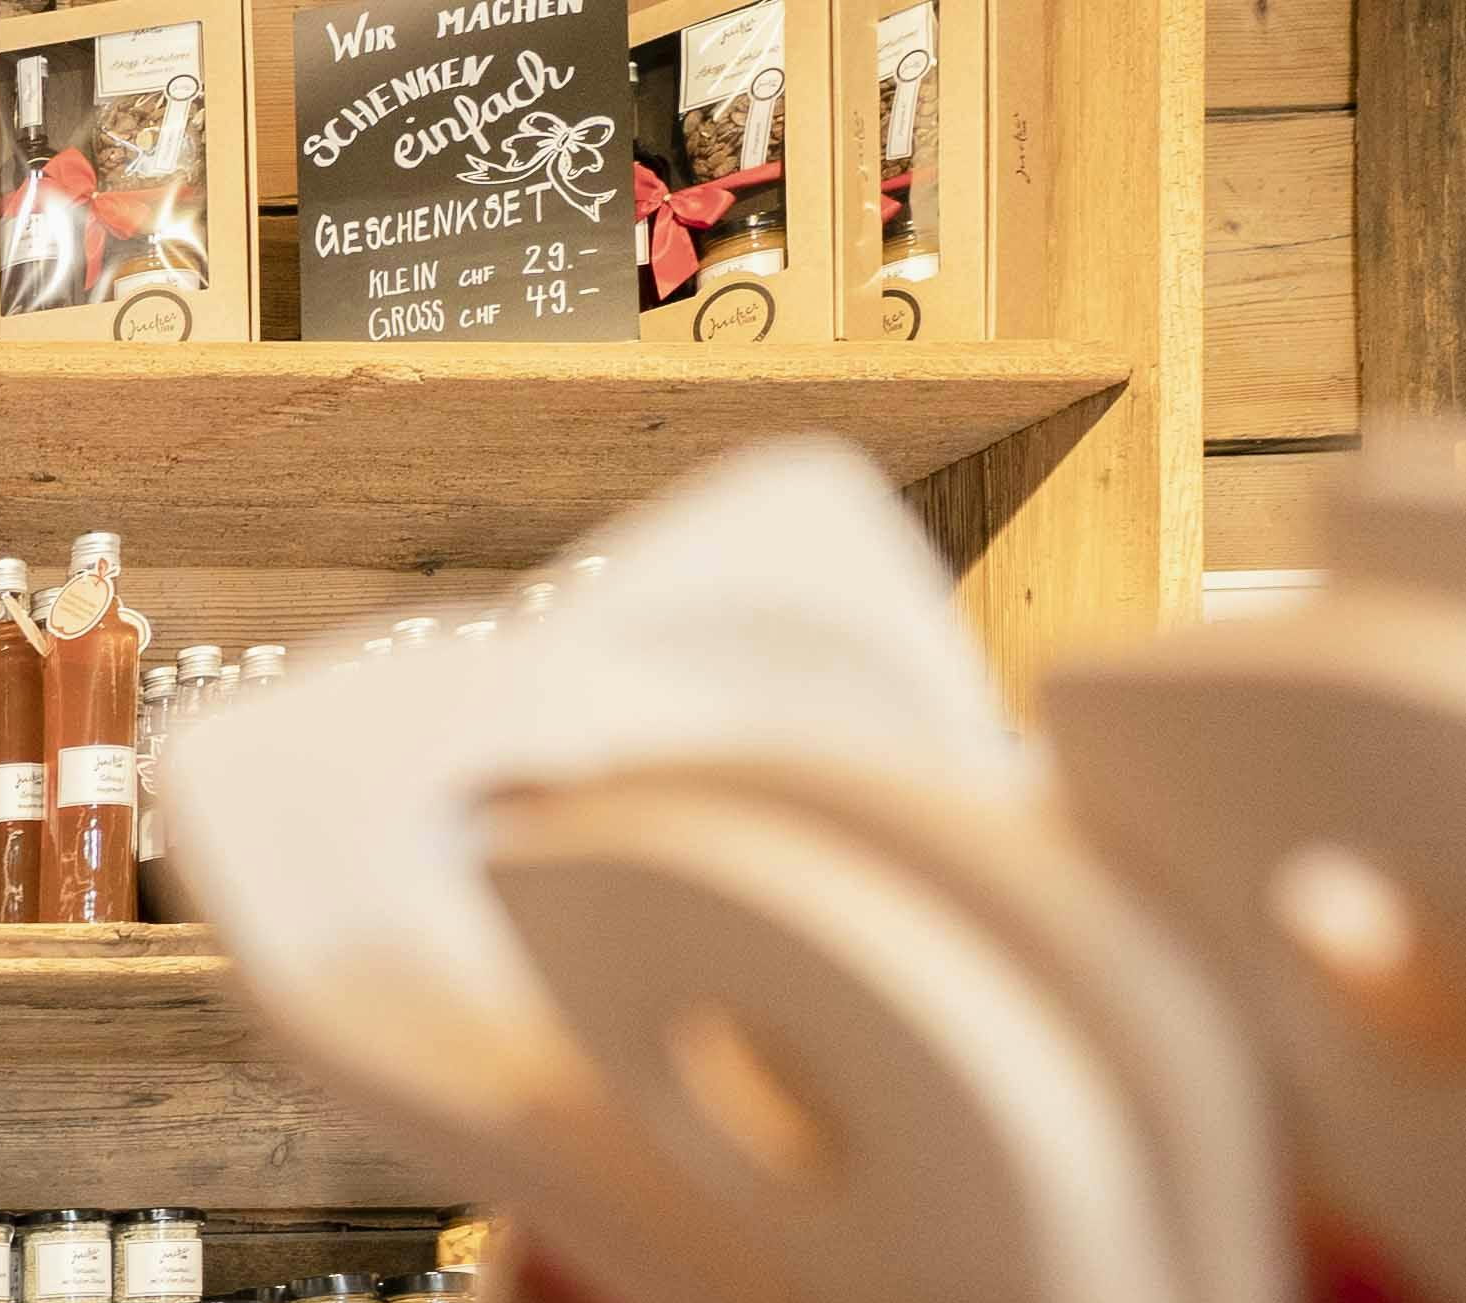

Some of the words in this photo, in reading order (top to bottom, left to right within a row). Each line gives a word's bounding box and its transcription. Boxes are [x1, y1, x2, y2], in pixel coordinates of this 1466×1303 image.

[326, 12, 396, 63] WIR
[436, 0, 586, 38] MACHEN
[303, 55, 495, 167] SCHENKEN
[393, 50, 575, 168] einfach
[314, 182, 554, 258] GESCHENKSET
[368, 261, 439, 299] KLEIN
[458, 266, 496, 287] CHF
[368, 300, 444, 342] GROSS
[459, 304, 501, 328] CHF
